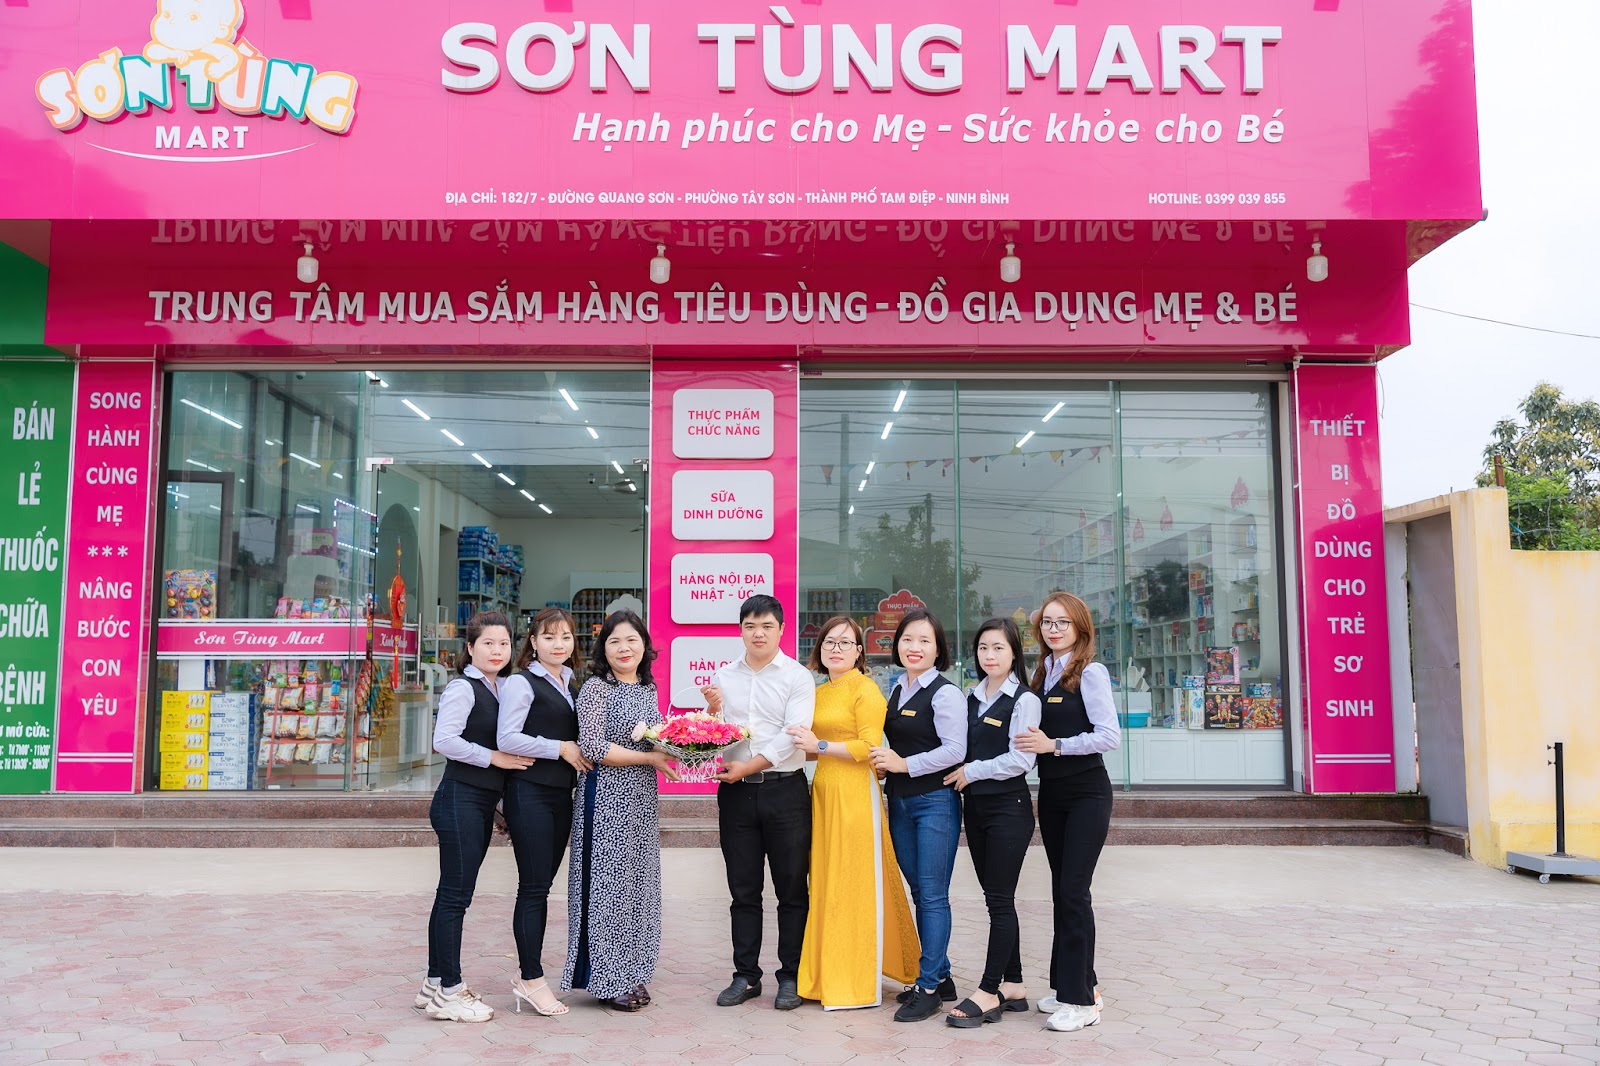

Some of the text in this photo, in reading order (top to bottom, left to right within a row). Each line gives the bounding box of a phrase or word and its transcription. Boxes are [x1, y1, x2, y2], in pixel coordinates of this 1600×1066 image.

[441, 5, 1283, 93] SƠN TÙNG MART
[34, 36, 358, 134] SƠN TÙNG
[155, 125, 249, 150] MART
[572, 111, 671, 152] Hạnh
[680, 107, 777, 150] phúc
[789, 112, 860, 144] cho
[872, 112, 926, 151] Mẹ
[962, 106, 1032, 144] Sức
[1044, 108, 1140, 144] khỏe
[1154, 112, 1223, 144] cho
[1236, 108, 1286, 144] Bé
[445, 192, 468, 206] ĐỊA
[470, 188, 498, 204] CHỈ:
[501, 192, 538, 204] 182/7
[548, 189, 595, 204] ĐƯỜNG
[598, 192, 646, 204] QUANG
[648, 191, 675, 204] SƠN
[685, 189, 739, 204] PHƯỜNG
[742, 190, 765, 204] TÂY
[767, 191, 796, 204] SƠN
[805, 190, 847, 204] THÀNH
[850, 186, 878, 204] PHỐ
[880, 193, 906, 204] TAM
[908, 190, 937, 206] ĐIỆP
[946, 193, 977, 204] NINH
[979, 190, 1010, 204] BÌNH
[1148, 193, 1286, 204] HOTLINE: 0399 039 855
[149, 289, 272, 322] TRUNG
[290, 281, 361, 323] TÂM
[379, 290, 456, 322] MUA
[467, 277, 543, 322] SẮM
[557, 280, 660, 323] HÀNG
[674, 282, 750, 322] TIÊU
[765, 281, 868, 323] DÙNG
[897, 276, 948, 323] ĐỒ
[964, 291, 1023, 323] GIA
[1035, 290, 1137, 330] DỤNG
[1153, 291, 1202, 330] MẸ
[1216, 291, 1242, 323] &
[1255, 282, 1298, 323] BÉ
[90, 391, 142, 409] SONG
[13, 401, 55, 441] BÁN
[688, 409, 721, 422] THỰC
[1310, 413, 1365, 437] THIẾT
[87, 424, 140, 447] HÀNH
[688, 423, 760, 435] CHỨC NĂNG
[18, 461, 41, 506] LẺ
[86, 461, 138, 485] CÙNG
[1331, 464, 1349, 486] BỊ
[710, 489, 736, 503] SỮA
[96, 505, 123, 526] MẸ
[683, 506, 764, 520] DINH DƯỠNG
[1327, 498, 1356, 521] ĐỒ
[1315, 535, 1372, 559] DÙNG
[79, 576, 133, 599] NÂNG
[679, 571, 766, 587] HÀNG NỘI ĐỊA
[1323, 578, 1366, 597] CHO
[691, 586, 725, 603] NHẬT
[737, 586, 755, 600] ÚC
[0, 597, 49, 638] CHỮA
[77, 614, 131, 638] BƯỚC
[1327, 611, 1366, 635] TRẺ
[193, 630, 325, 648] Sơn Tùng Mart
[81, 658, 121, 677] CON
[689, 657, 717, 671] HÀN
[1333, 655, 1363, 673] SƠ
[81, 692, 118, 717] YÊU
[1326, 700, 1374, 718] SINH
